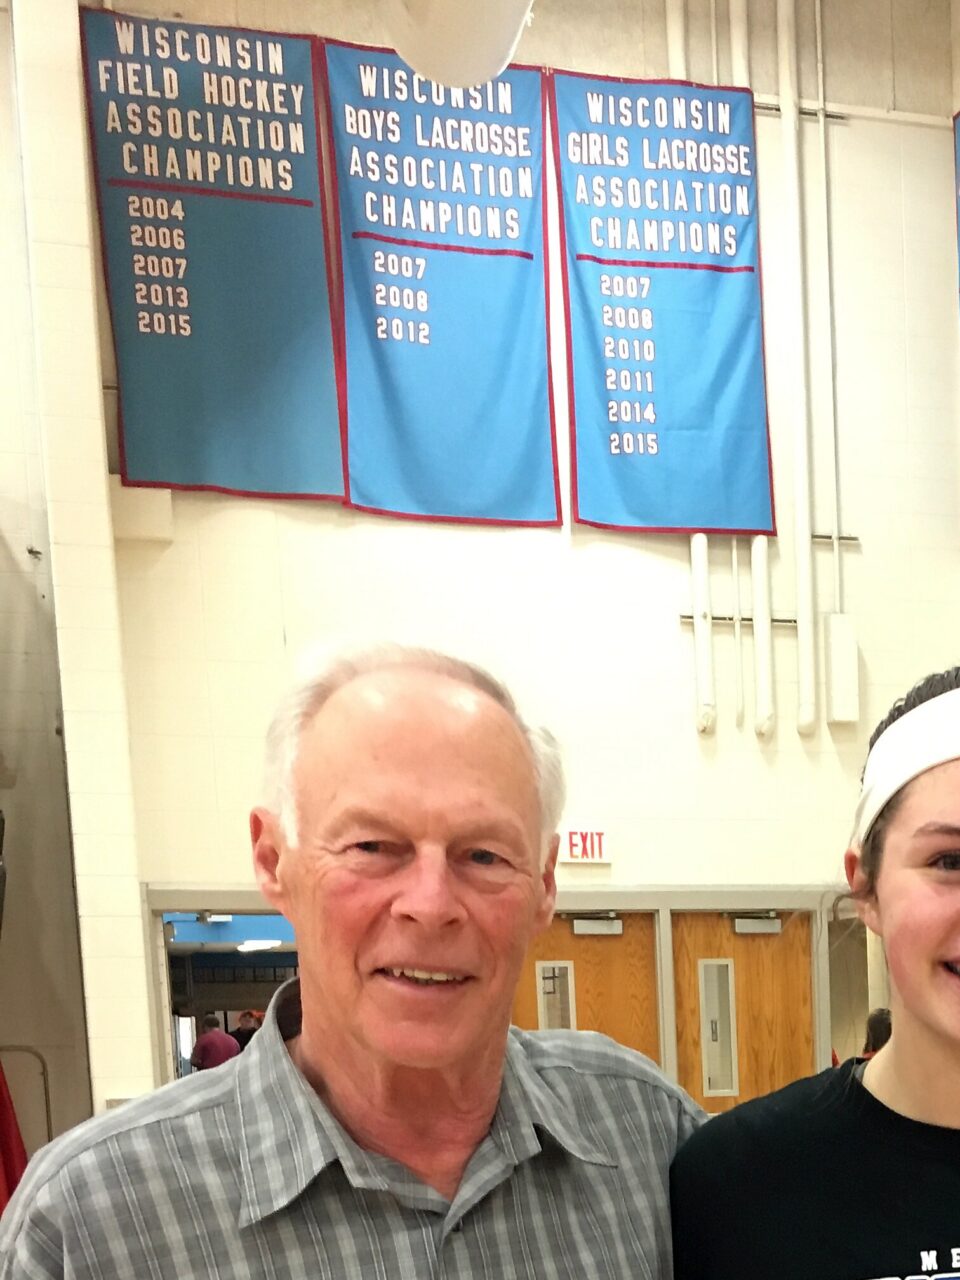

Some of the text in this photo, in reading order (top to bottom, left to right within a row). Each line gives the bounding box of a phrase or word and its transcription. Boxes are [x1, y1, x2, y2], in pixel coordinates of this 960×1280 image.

[115, 20, 283, 75] WISCONSIN
[98, 60, 304, 116] FIELD HOCKEY
[359, 64, 512, 114] WISCONSIN
[106, 100, 305, 154] ASSOCIATION
[587, 91, 732, 135] WISCONSIN
[345, 104, 532, 157] BOYS LACROSSE
[122, 142, 293, 191] CHAMPIONS
[567, 133, 752, 177] GIRLS LACROSSE
[350, 146, 533, 198] ASSOCIATION
[128, 195, 186, 221] 2004
[575, 173, 751, 217] ASSOCIATION
[365, 191, 520, 239] CHAMPIONS
[130, 225, 186, 250] 2006
[590, 216, 738, 256] CHAMPIONS
[133, 254, 188, 280] 2007
[374, 251, 427, 280] 2007
[135, 283, 190, 308] 2013
[375, 283, 429, 312] 2008
[600, 274, 651, 299] 2007
[138, 311, 192, 337] 2015
[376, 317, 431, 345] 2012
[602, 305, 654, 331] 2008
[604, 337, 655, 362] 2010
[605, 368, 654, 393] 2011
[608, 400, 657, 424] 2014
[609, 432, 659, 455] 2015
[569, 831, 604, 859] EXIT
